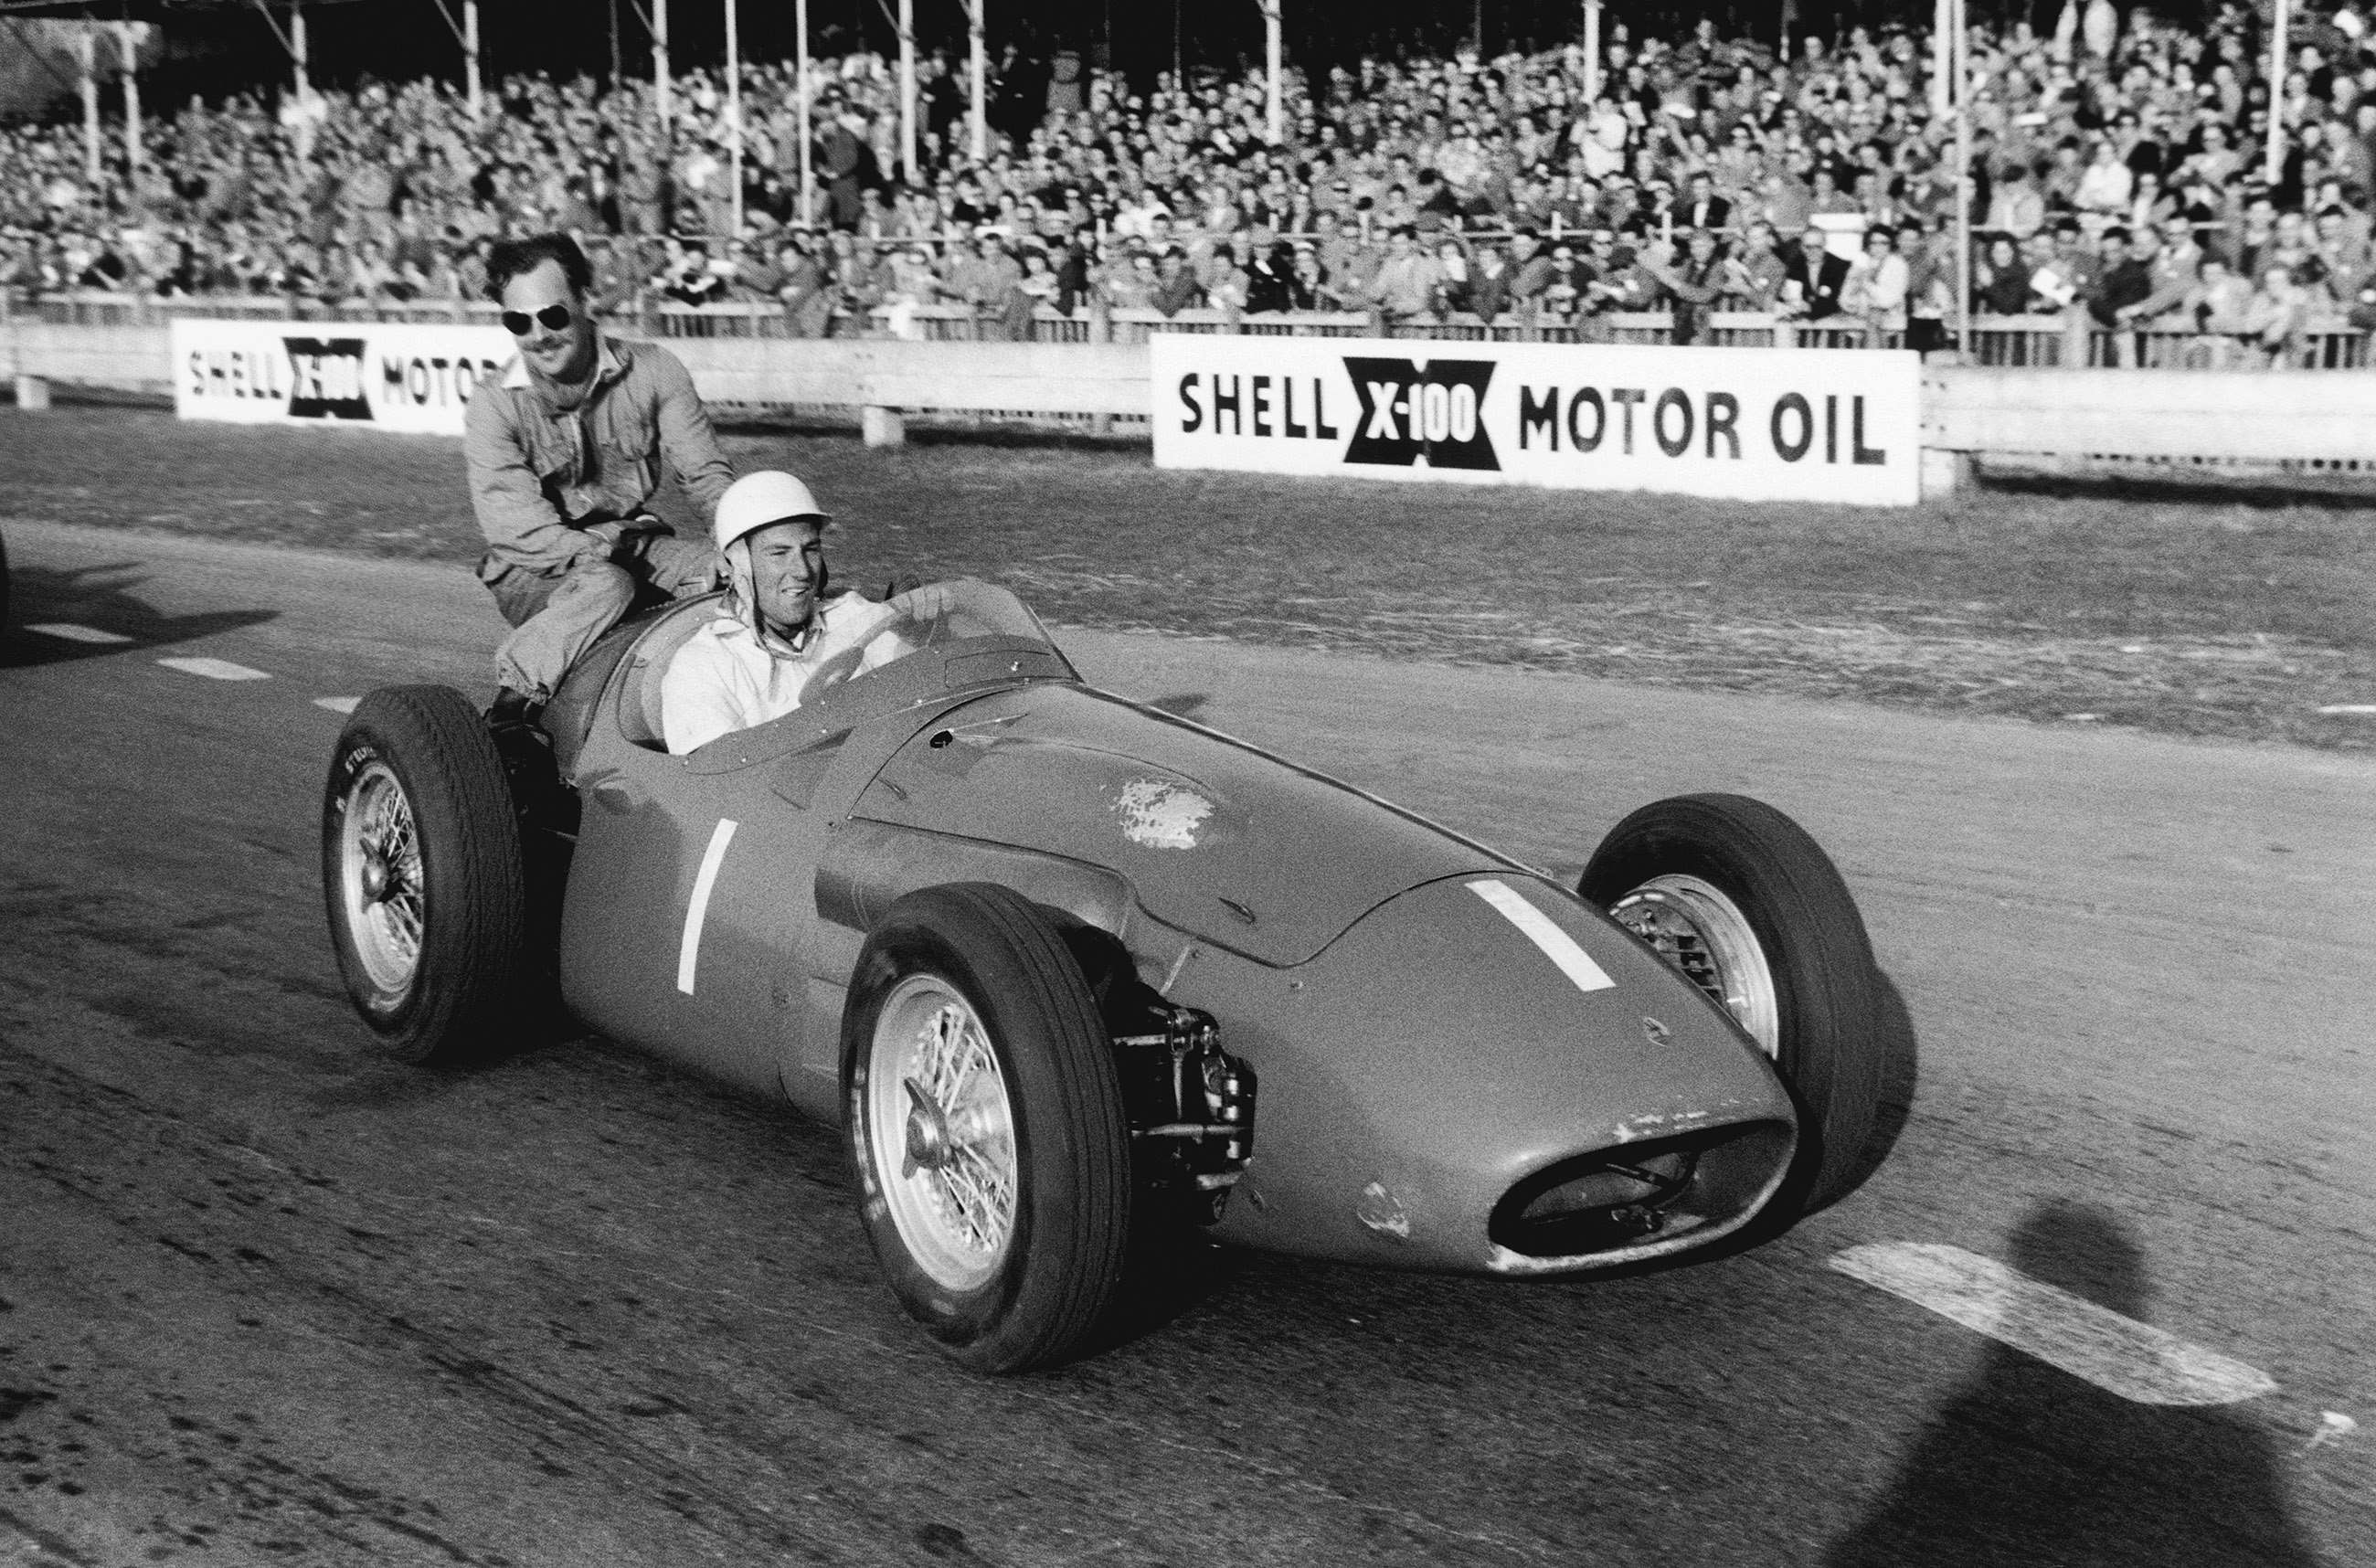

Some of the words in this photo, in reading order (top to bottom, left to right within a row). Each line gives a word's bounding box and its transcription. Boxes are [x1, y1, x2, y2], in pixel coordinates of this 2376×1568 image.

[188, 350, 283, 400] SHELL
[1179, 372, 1338, 440] SHELL
[1365, 381, 1477, 443] X-100
[1520, 385, 1740, 459] MOTOR
[1770, 392, 1886, 466] OIL
[677, 818, 739, 996] 1
[1465, 879, 1617, 992] 1
